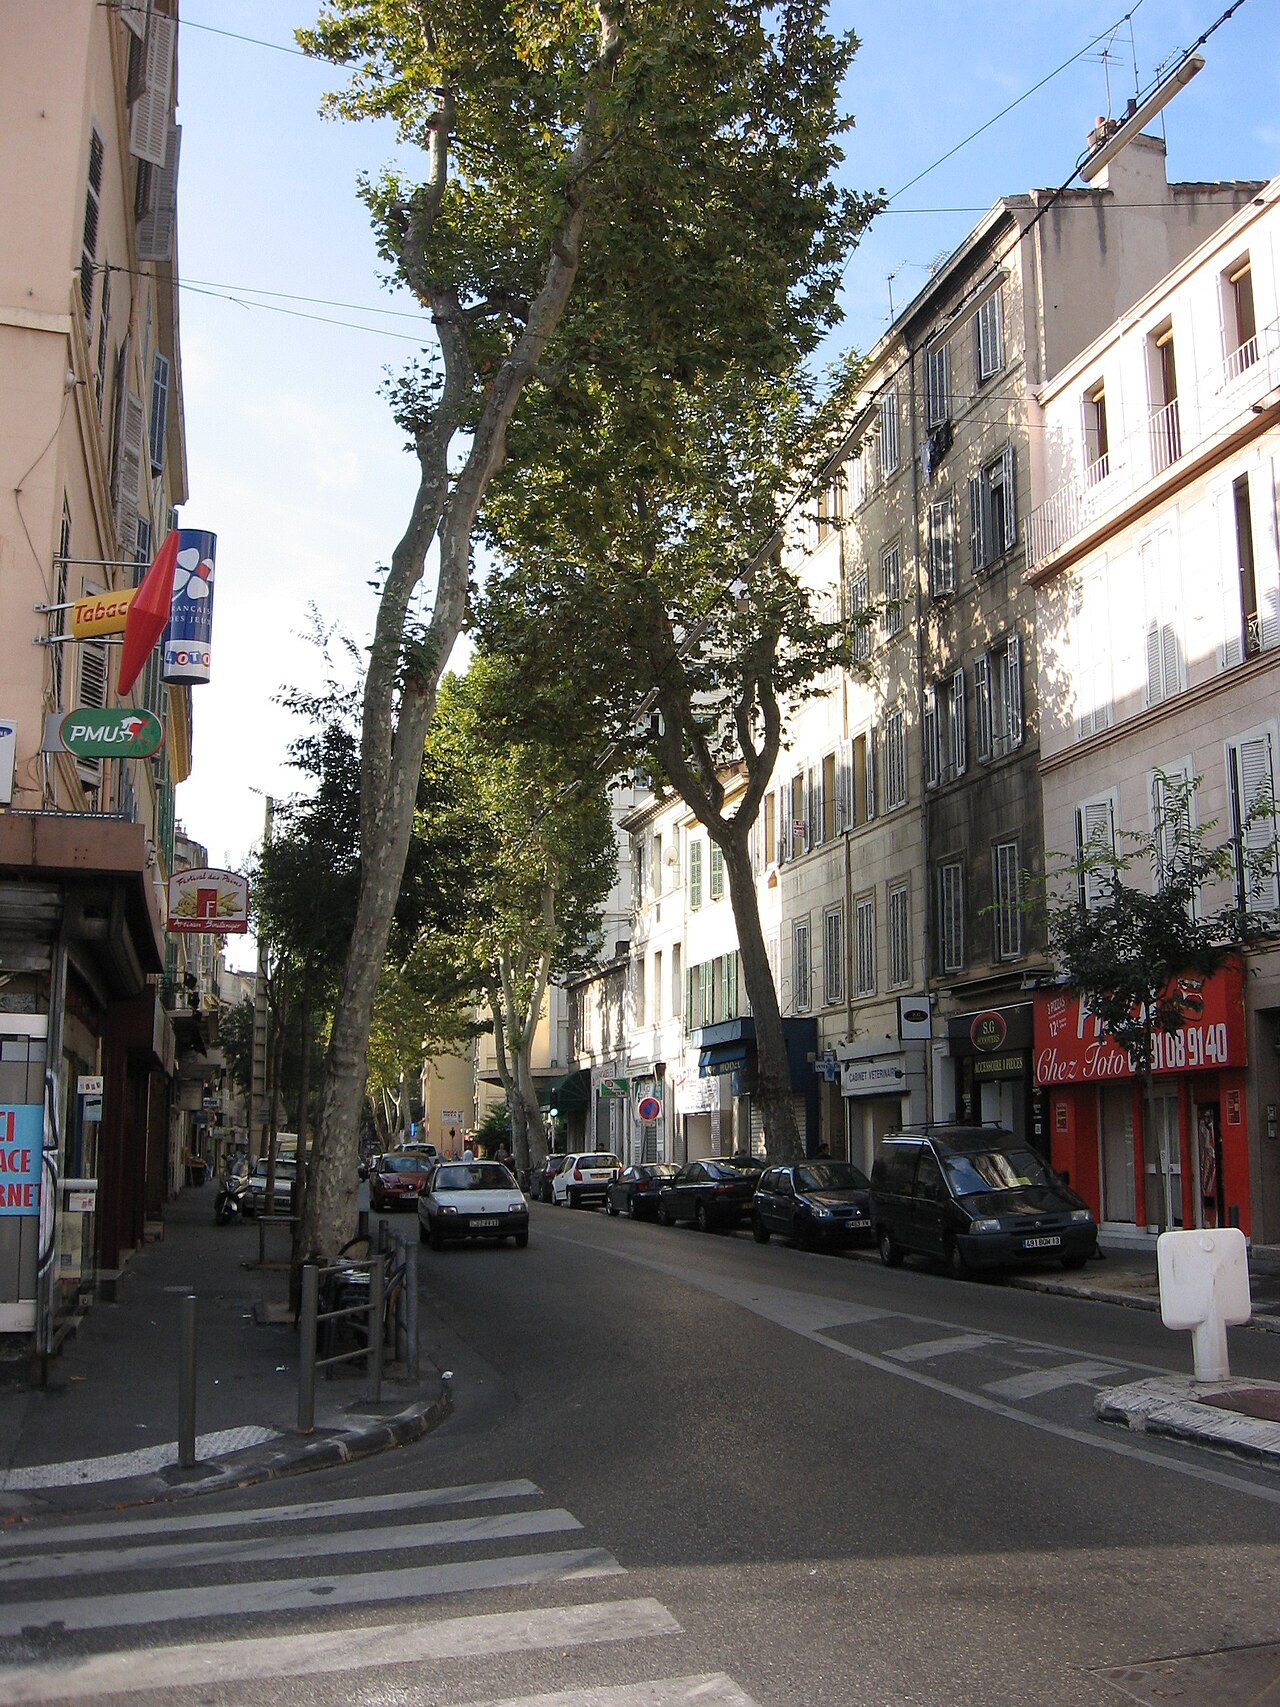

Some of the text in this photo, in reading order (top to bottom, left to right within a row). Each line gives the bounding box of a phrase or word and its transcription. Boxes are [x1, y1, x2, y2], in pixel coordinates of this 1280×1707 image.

[75, 601, 127, 624] Tabac
[165, 651, 210, 667] LOTO
[70, 725, 119, 742] PMU
[1037, 1048, 1078, 1083] Chez
[1083, 1041, 1125, 1077] Toto
[849, 1071, 867, 1082] CABINET
